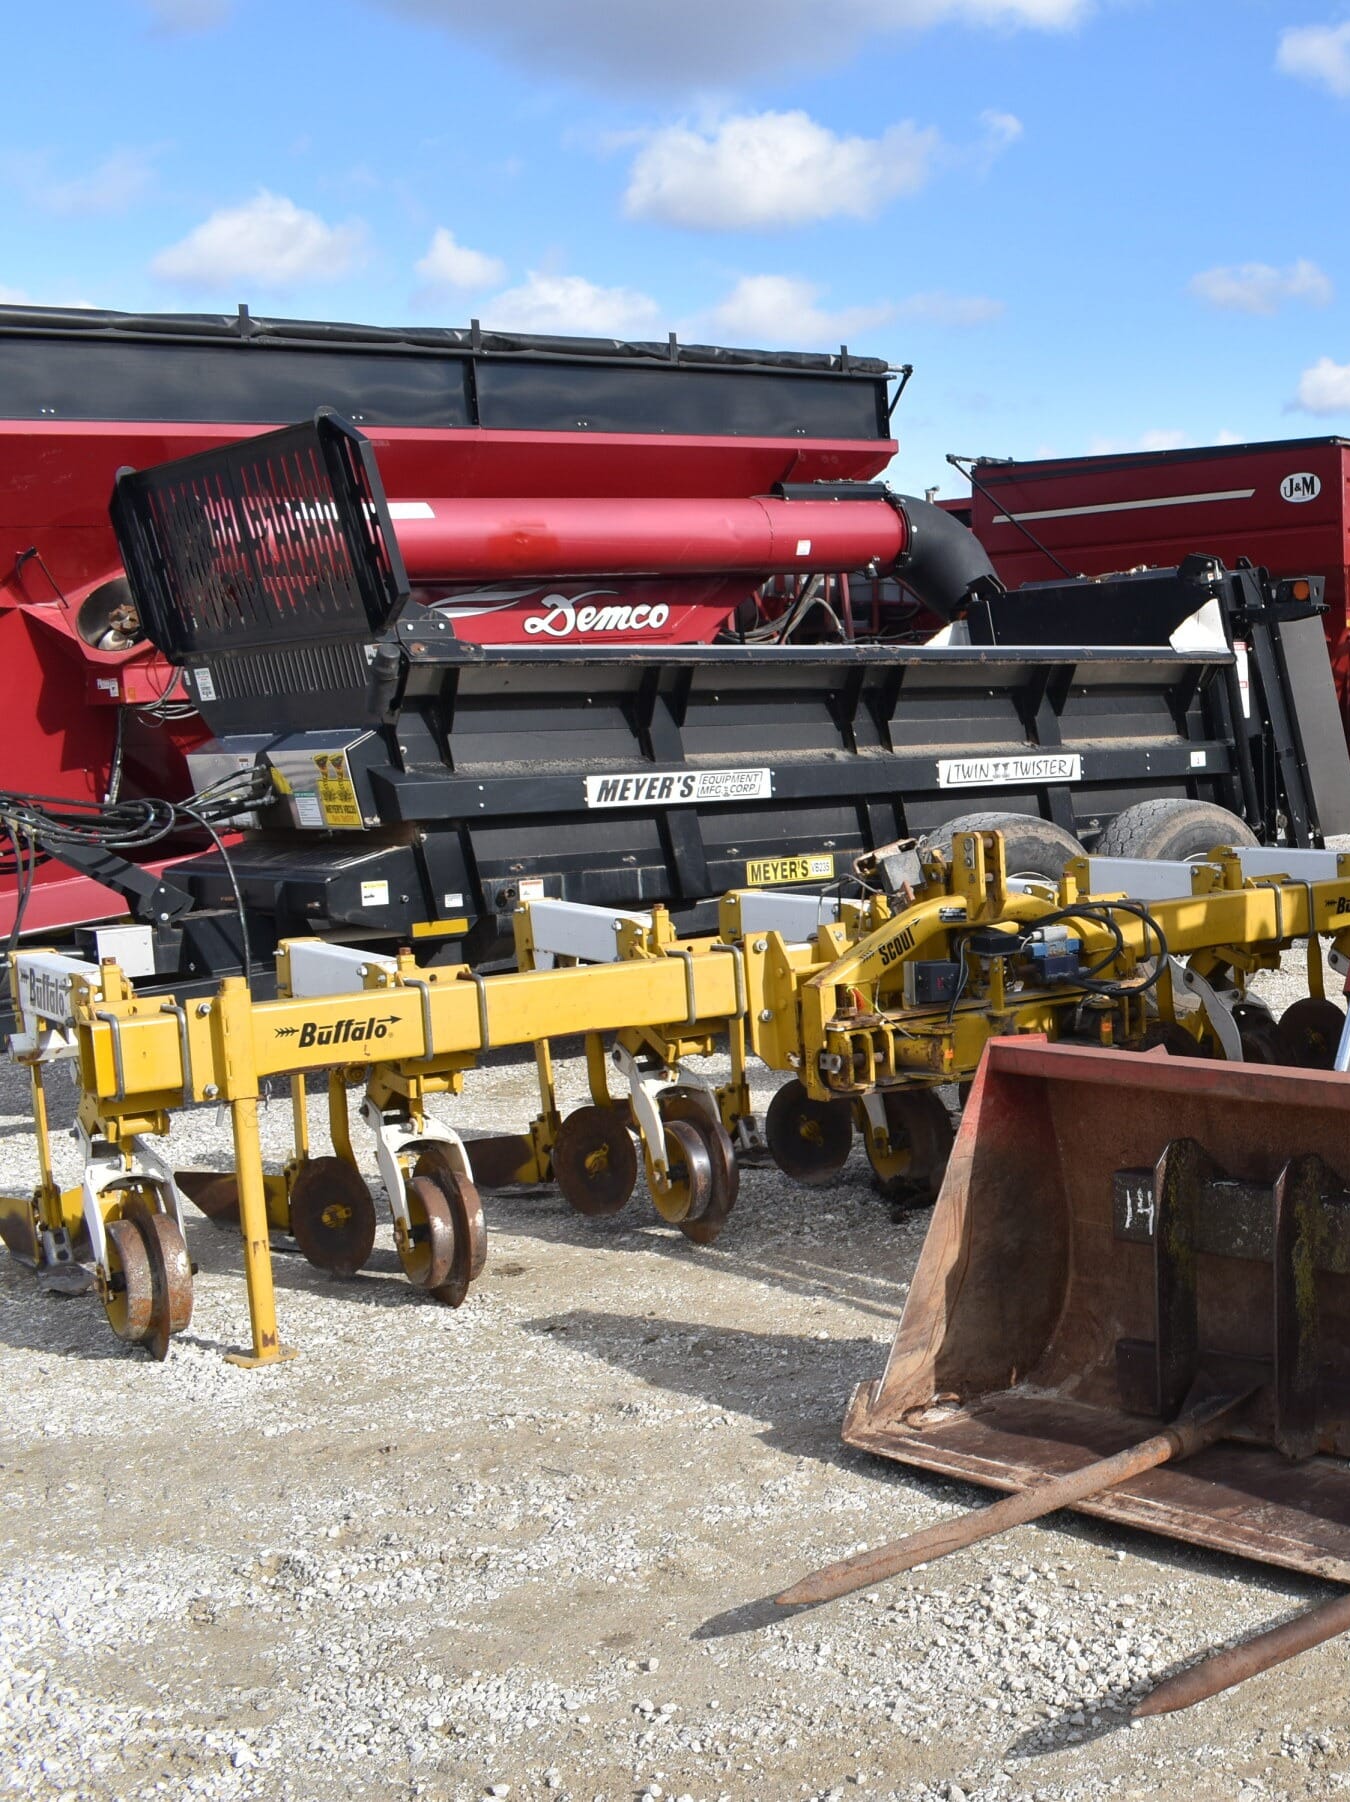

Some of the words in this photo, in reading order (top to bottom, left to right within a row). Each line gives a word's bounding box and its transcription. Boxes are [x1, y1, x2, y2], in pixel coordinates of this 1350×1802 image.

[1283, 475, 1315, 498] J&M
[523, 590, 670, 637] Demco
[702, 773, 760, 785] EQUIPMENT
[954, 763, 989, 779] TWIN
[1013, 759, 1068, 776] TWISTER
[597, 775, 696, 802] MEYER'S
[751, 860, 809, 882] MEYER'S
[878, 926, 915, 966] SCOUT
[30, 967, 66, 1017] Buffalo
[298, 1017, 388, 1048] Buffalo
